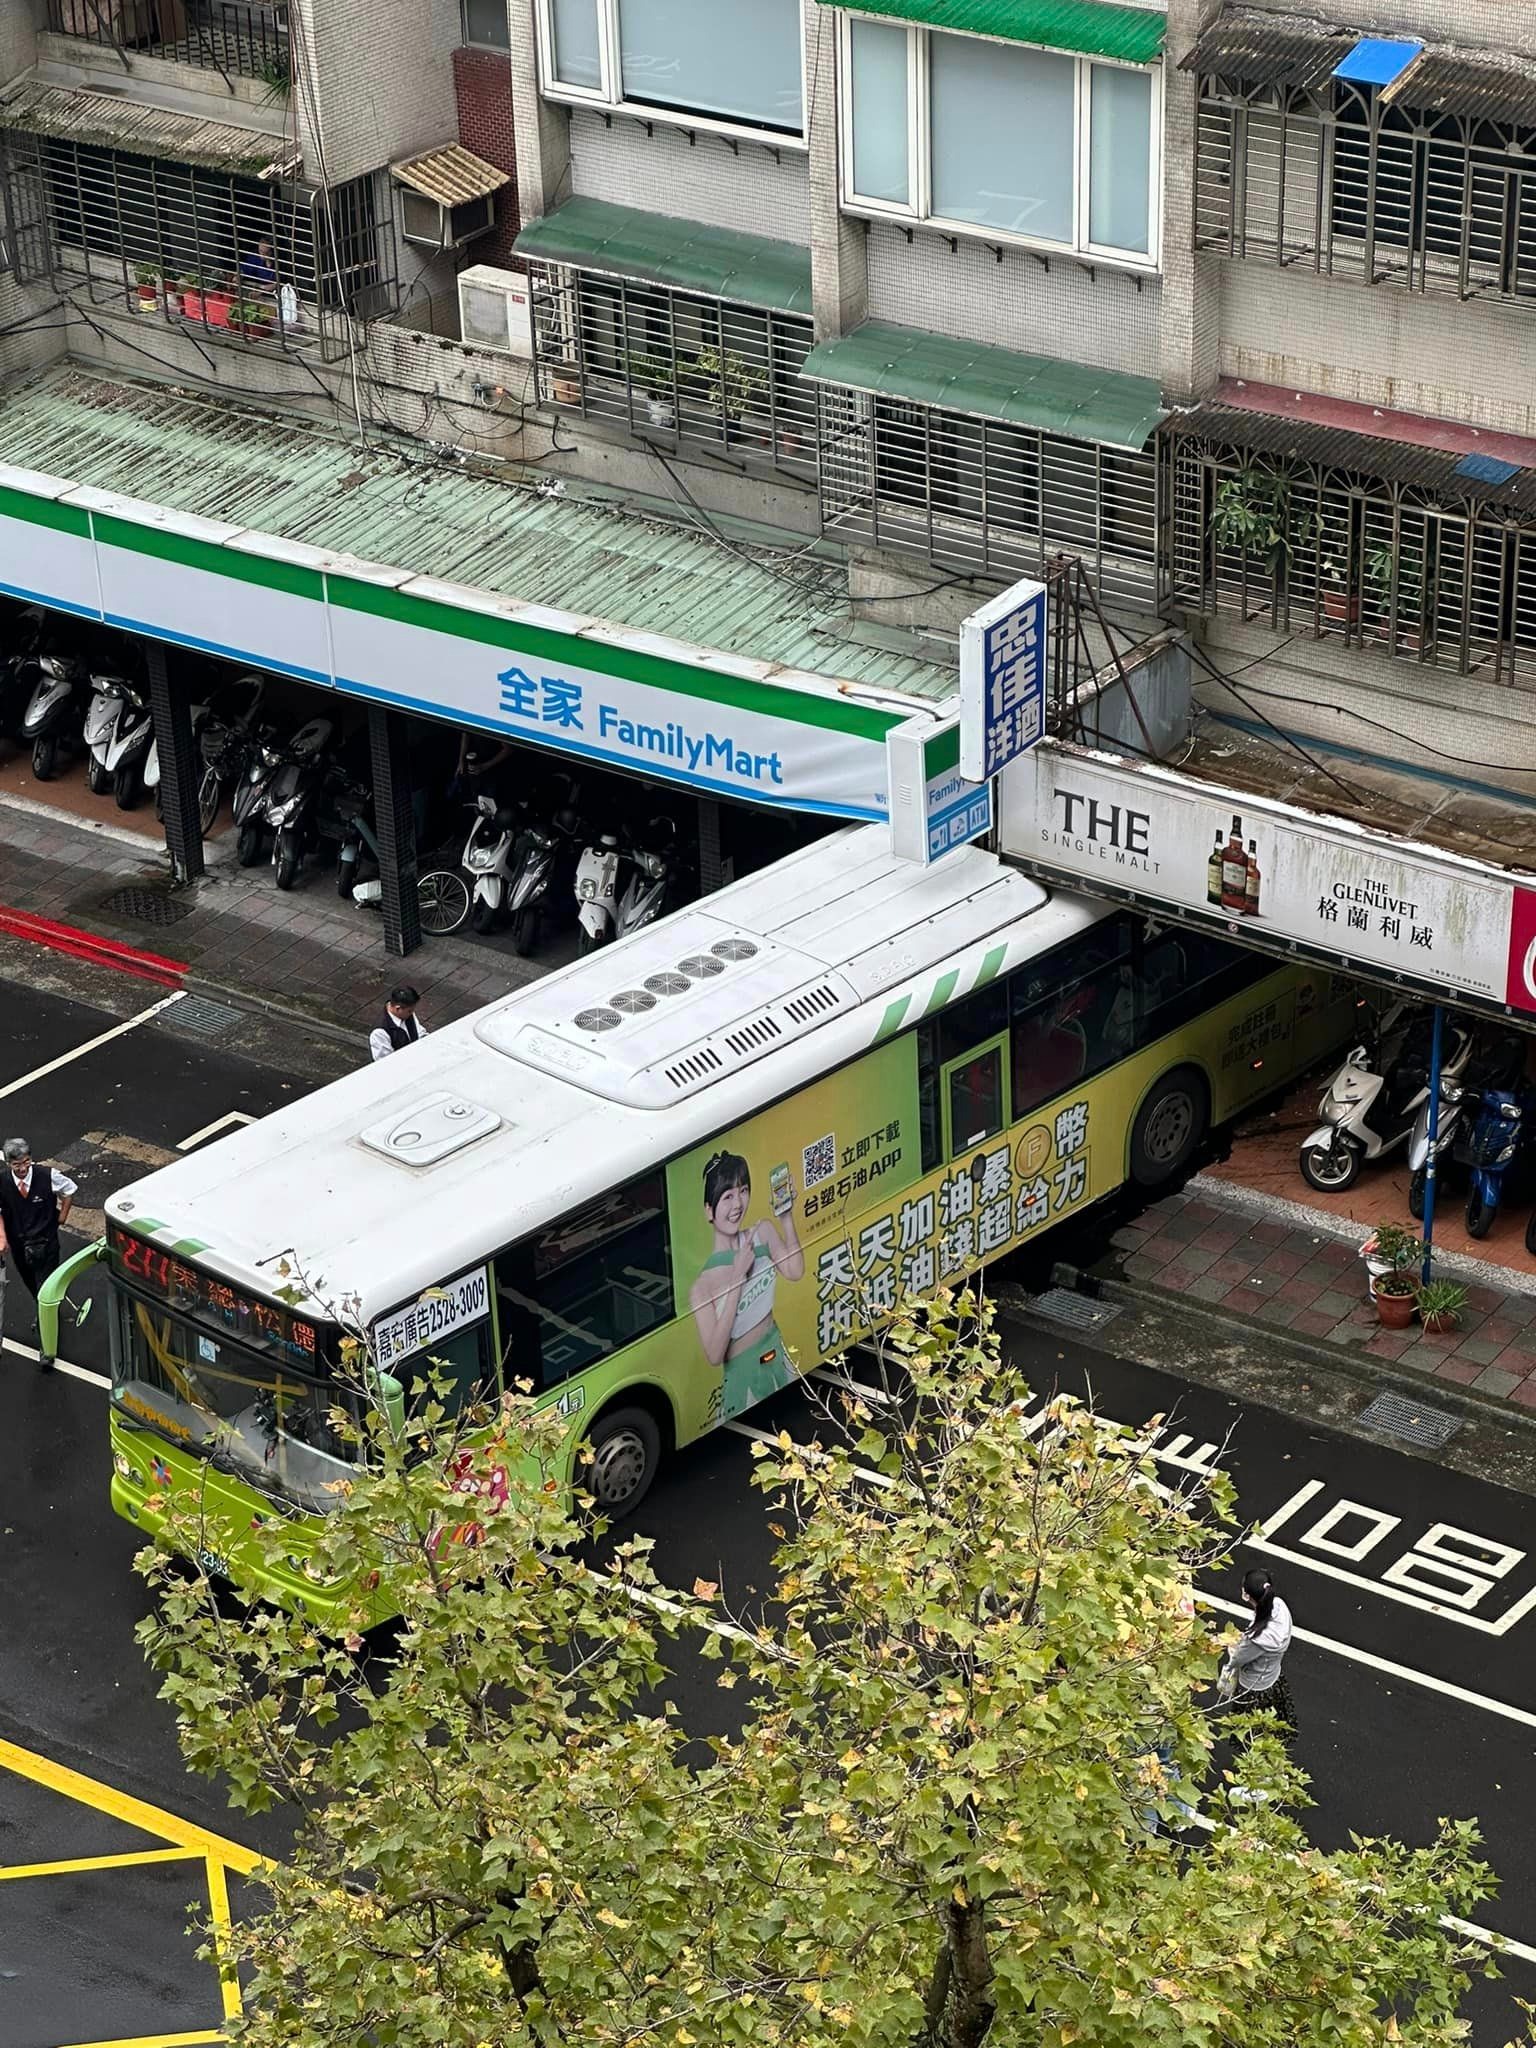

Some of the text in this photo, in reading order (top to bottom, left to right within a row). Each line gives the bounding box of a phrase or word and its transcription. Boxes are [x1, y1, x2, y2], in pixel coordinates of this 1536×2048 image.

[497, 666, 783, 784] 全家 FamilyMart
[1053, 787, 1150, 857] THE
[1041, 828, 1161, 876] SINGLE MALT
[1333, 883, 1418, 920] GLENLIVET
[1364, 878, 1389, 895] THE
[1317, 896, 1434, 950] 格蘭利威
[841, 1119, 900, 1169] 立即下載
